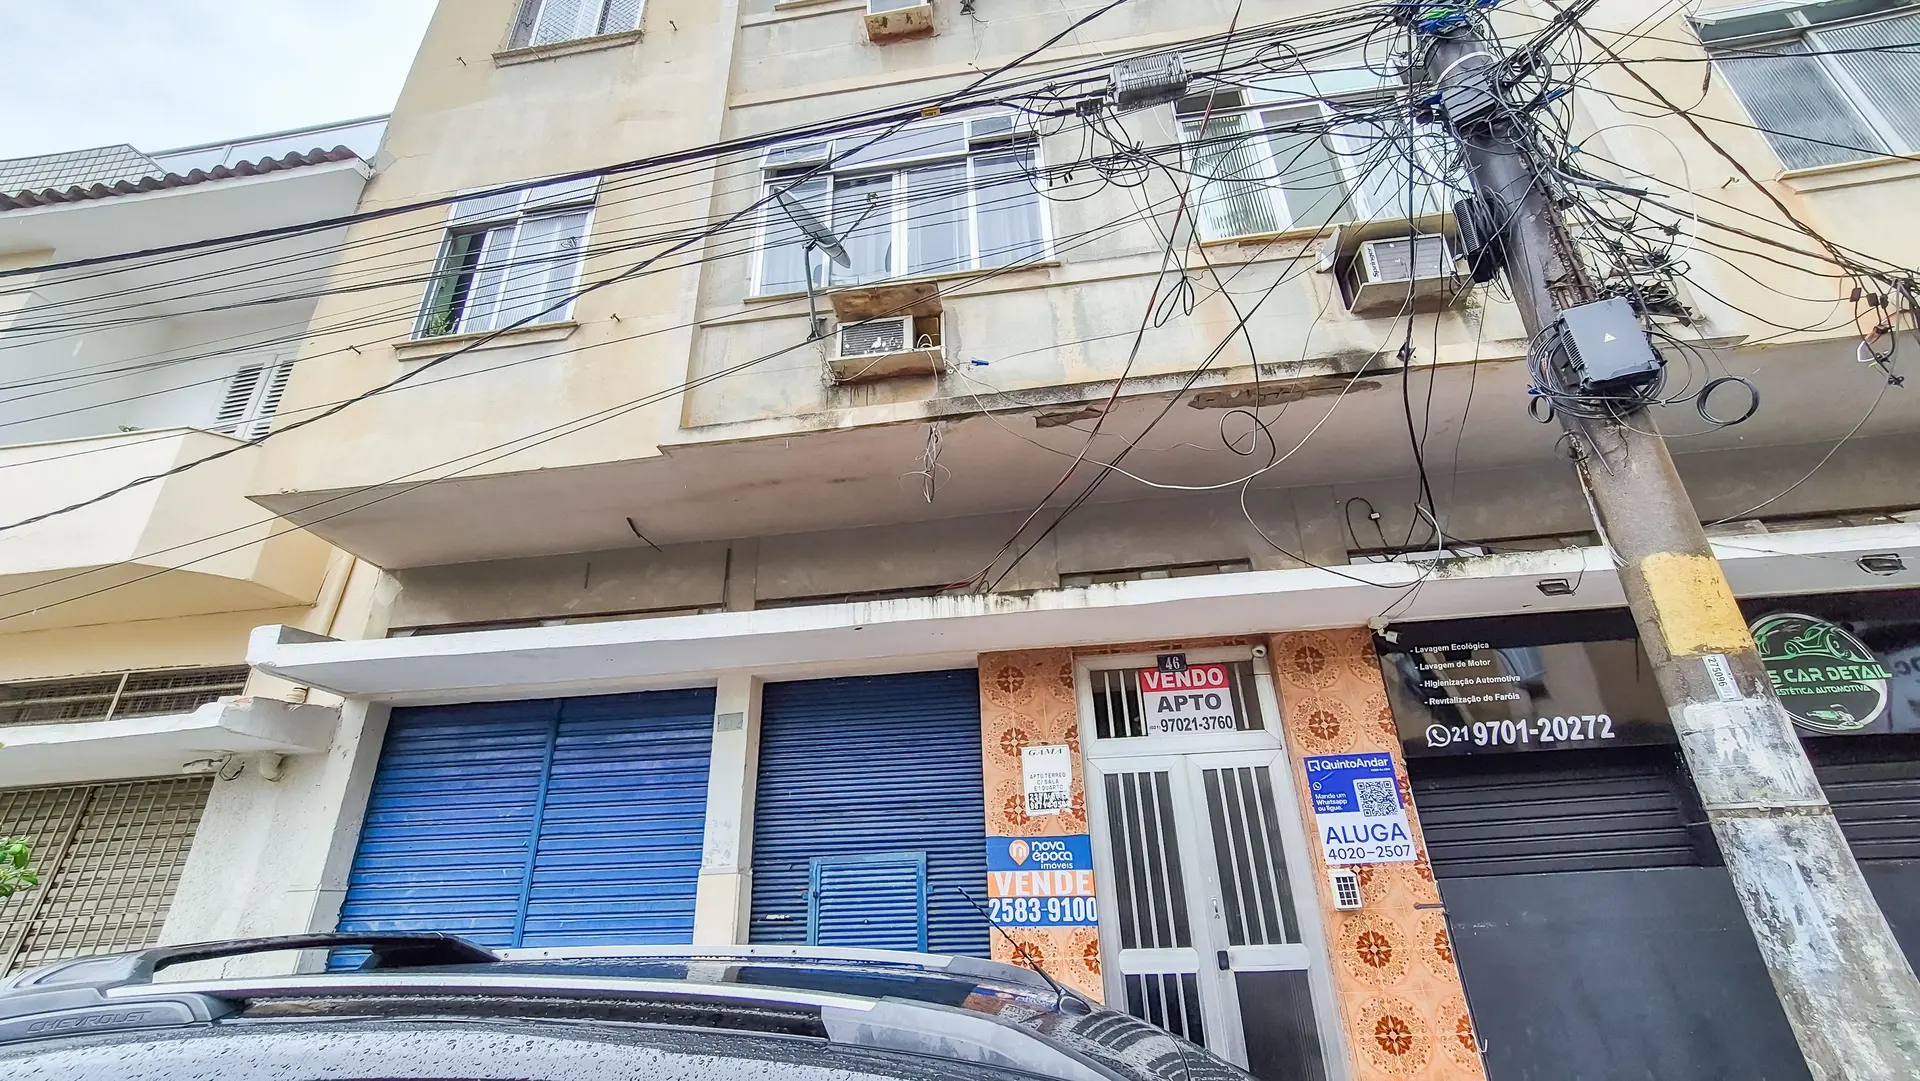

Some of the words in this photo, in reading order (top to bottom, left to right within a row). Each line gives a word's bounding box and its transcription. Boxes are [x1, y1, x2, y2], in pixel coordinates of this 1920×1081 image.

[1415, 645, 1449, 654] Lavagem
[1451, 642, 1489, 652] Ecológica
[1165, 656, 1180, 670] 46
[1420, 662, 1454, 671] Lavagem
[1467, 659, 1490, 667] Motor
[1143, 667, 1224, 689] VENDO
[1783, 667, 1825, 683] CAR
[1826, 664, 1893, 681] DETAIL
[1424, 677, 1474, 688] Higienização
[1475, 675, 1521, 684] Automotiva
[1815, 684, 1871, 694] AUTOMOTIVA
[1157, 693, 1222, 713] APTO
[1429, 695, 1481, 706] Revitalização
[1483, 694, 1493, 702] de
[1495, 692, 1520, 701] Faróis
[1160, 715, 1233, 733] 97021-3760
[1452, 726, 1469, 742] 21
[1472, 714, 1616, 746] 9701-20272
[1028, 748, 1062, 756] GAMA
[1321, 758, 1389, 770] QuintoAndar
[1326, 822, 1408, 845] ALUGA
[1031, 841, 1065, 851] nova
[1328, 844, 1410, 860] 4020-2507
[1032, 850, 1073, 863] época
[994, 871, 1091, 896] VENDE
[988, 897, 1098, 923] 2583-9100
[27, 1010, 152, 1034] CHEVROLET
